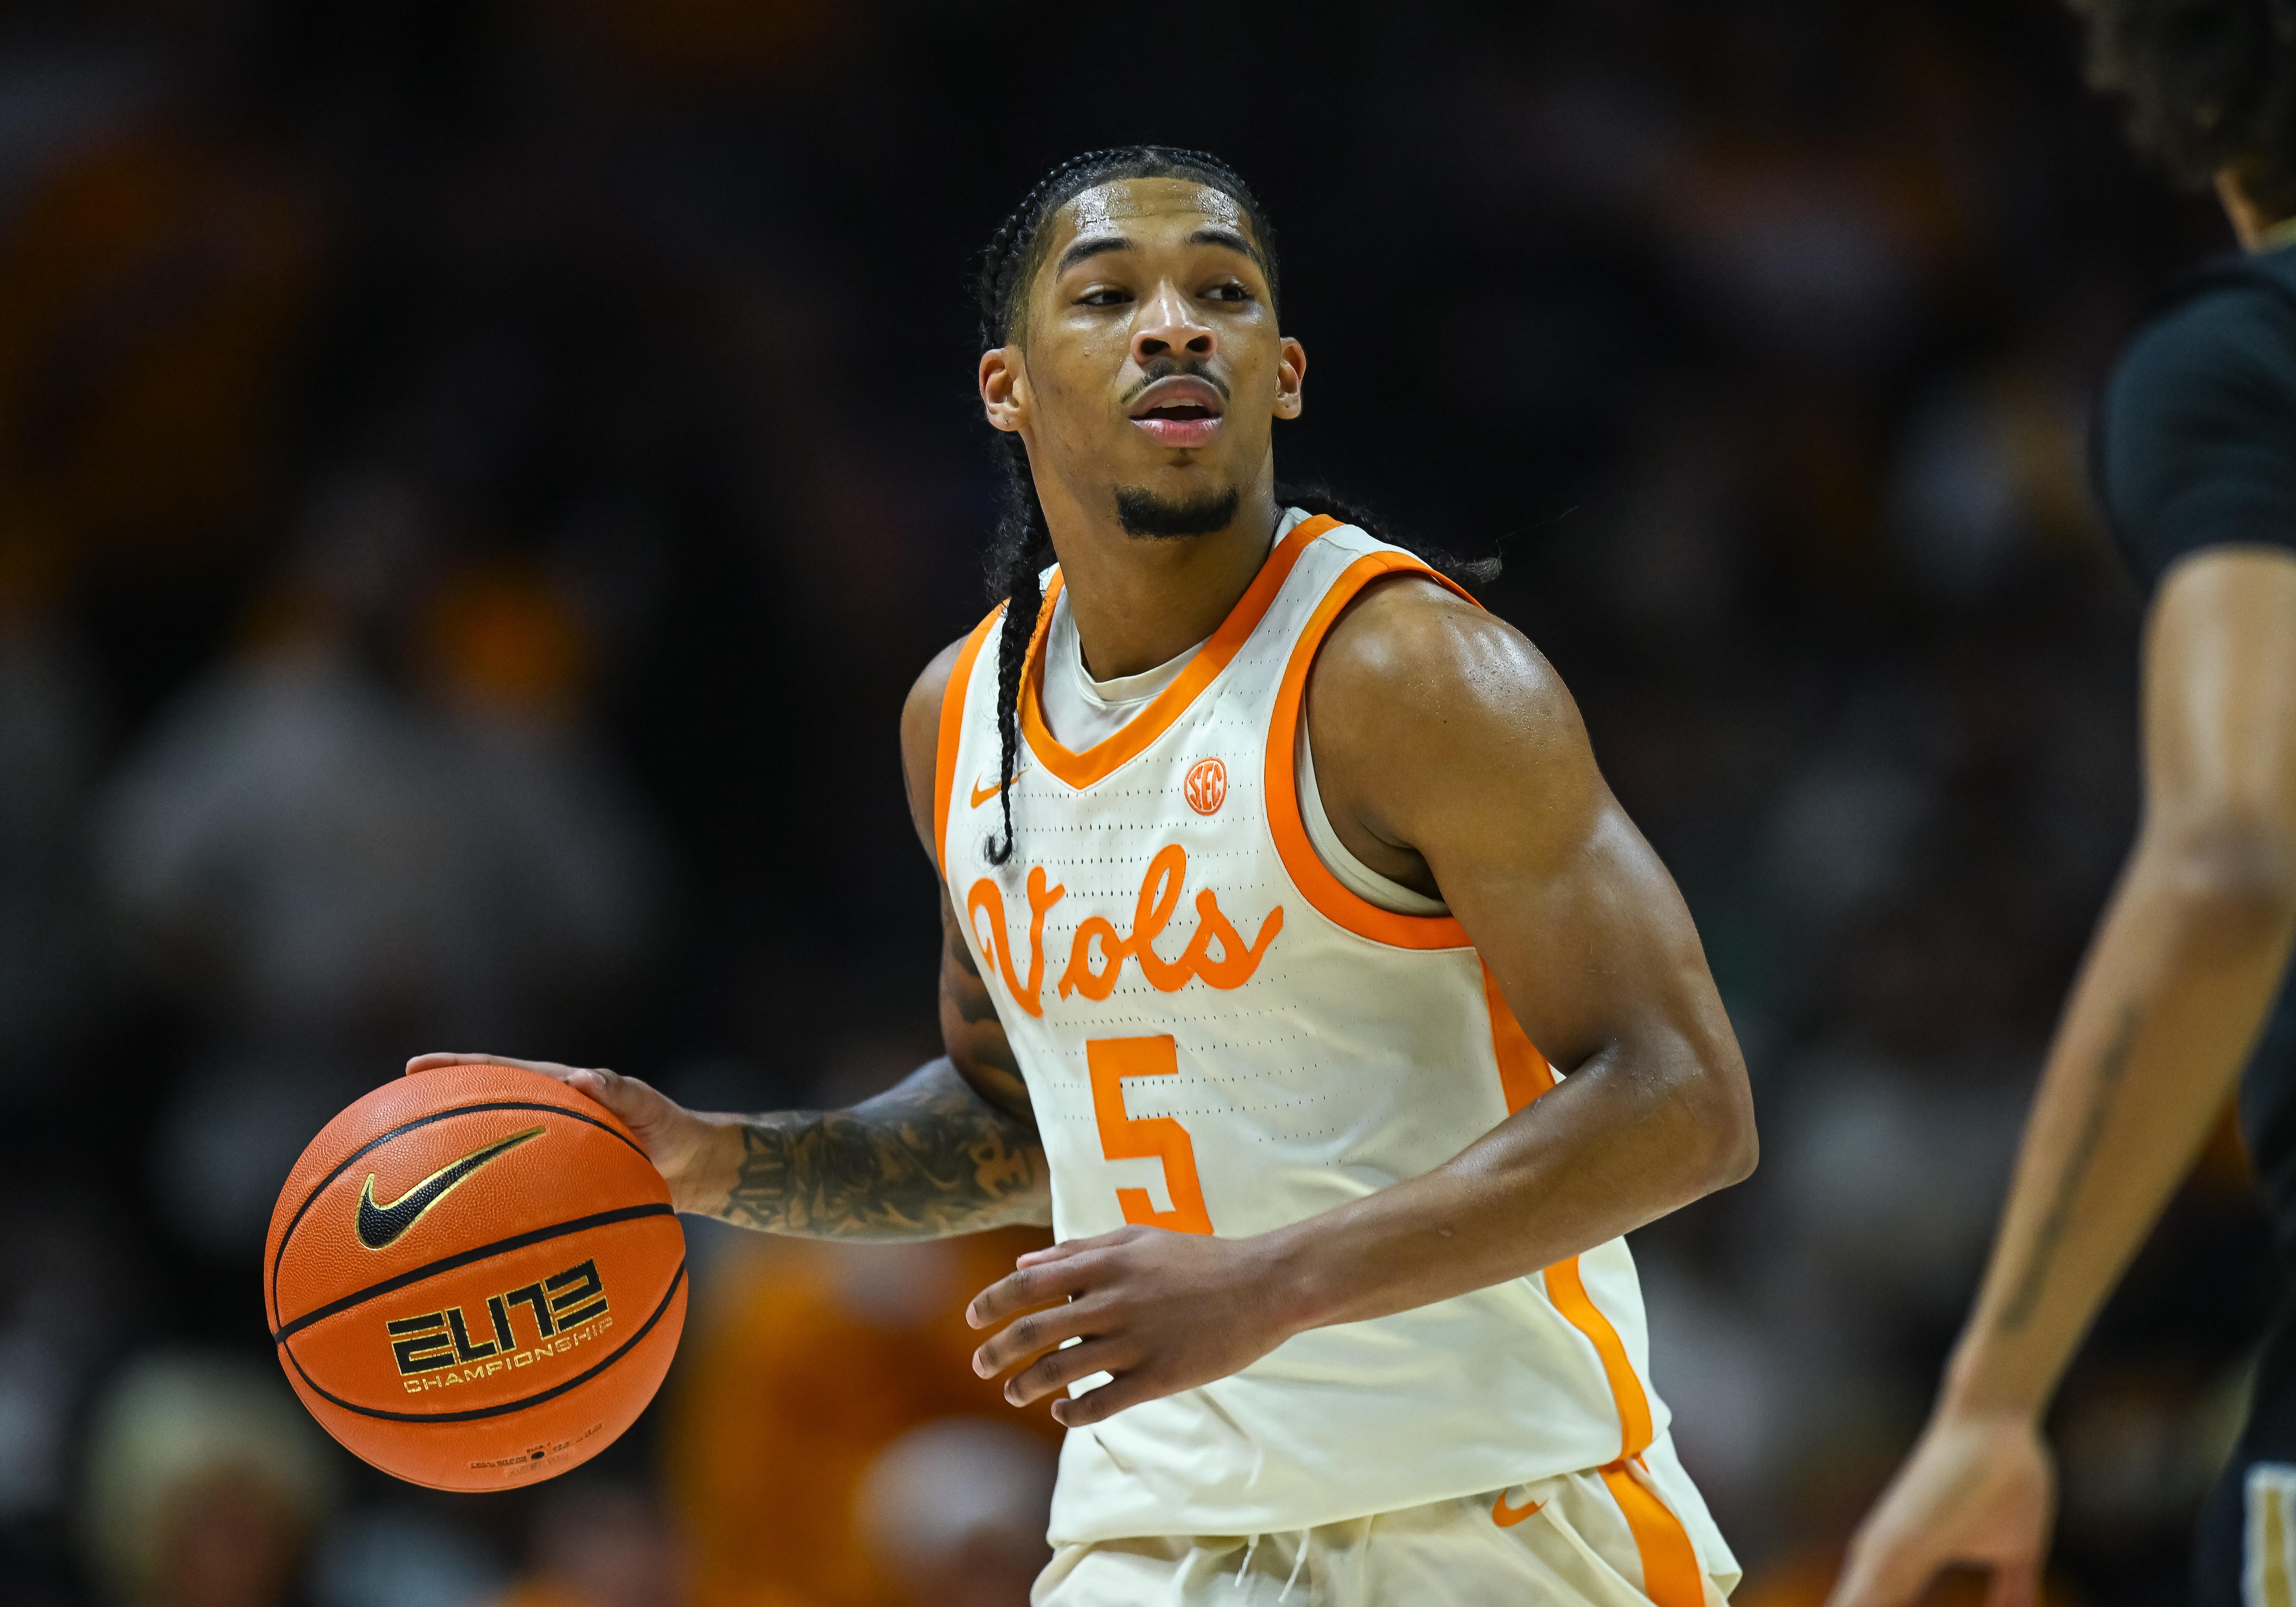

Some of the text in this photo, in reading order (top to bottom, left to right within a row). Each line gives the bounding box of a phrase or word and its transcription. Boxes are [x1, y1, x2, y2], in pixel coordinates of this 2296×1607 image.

[1188, 762, 1223, 810] SEC
[968, 843, 1283, 1018] Vols
[1086, 1034, 1214, 1236] 5
[385, 1257, 610, 1377] ELITE
[403, 1316, 613, 1393] CHAMPIONSHIP
